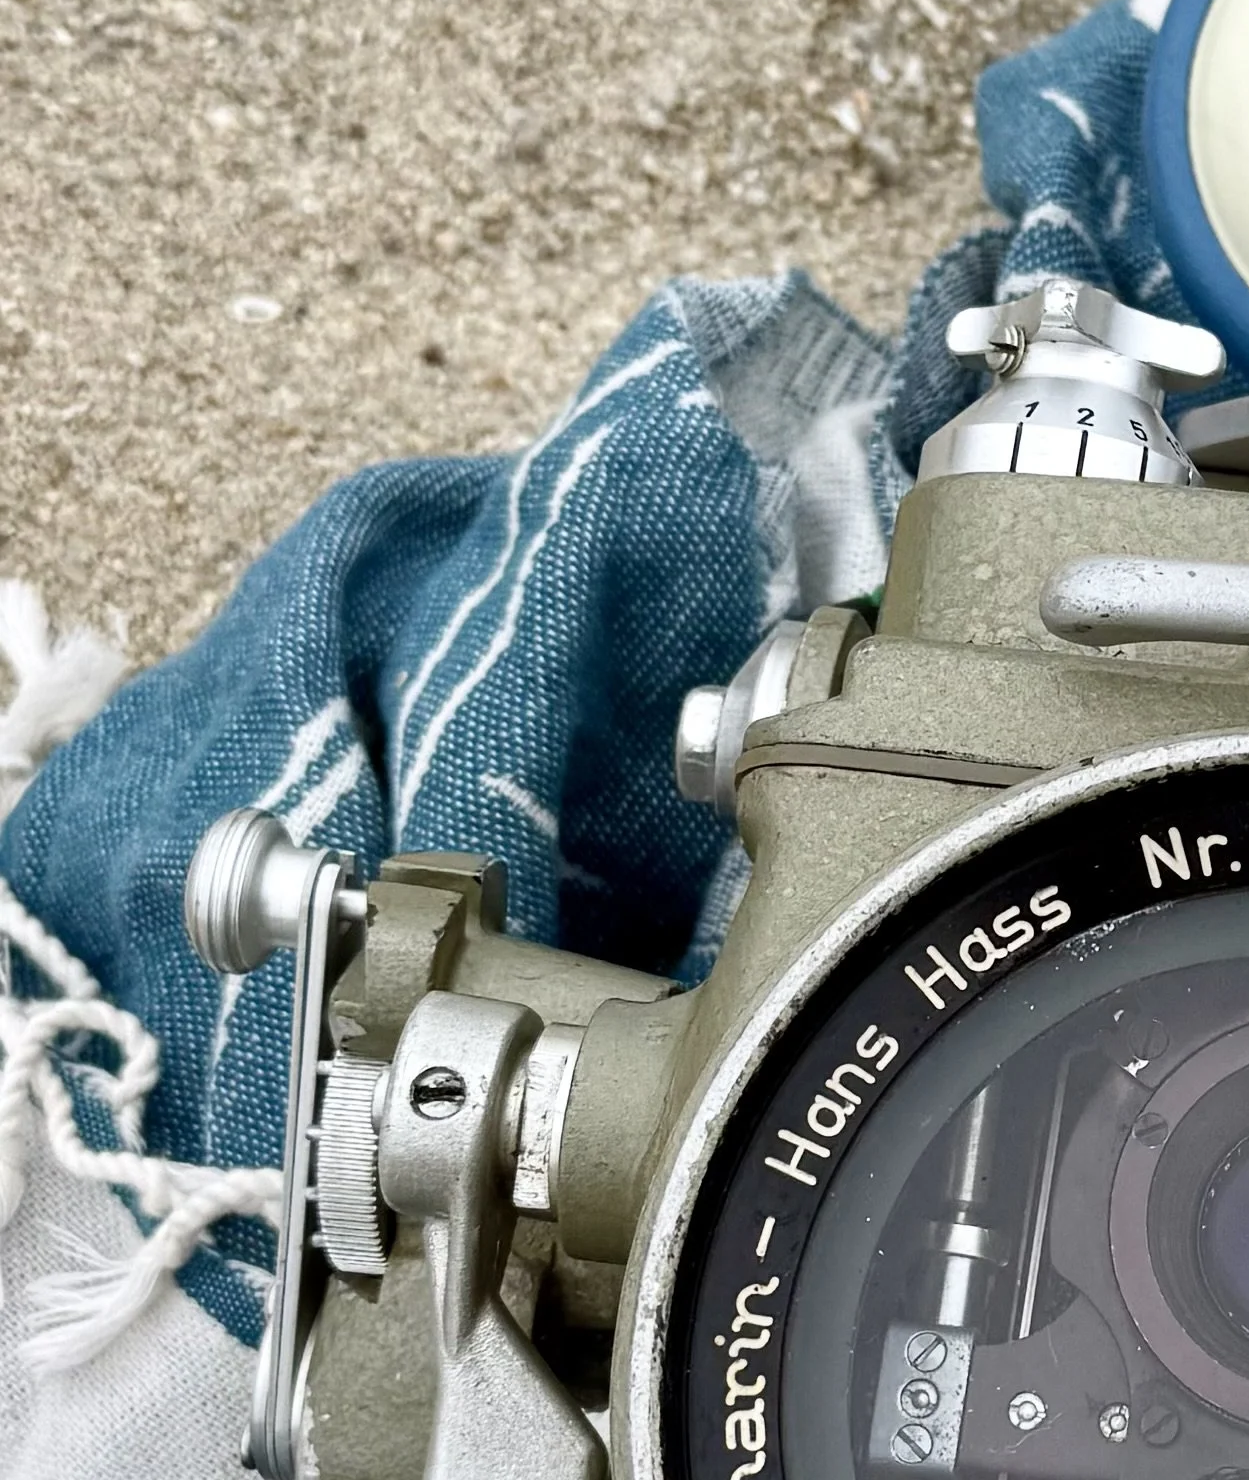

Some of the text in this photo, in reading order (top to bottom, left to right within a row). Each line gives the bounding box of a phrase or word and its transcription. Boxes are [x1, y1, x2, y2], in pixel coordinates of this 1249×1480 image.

[1025, 401, 1149, 442] 1 2 5
[1139, 826, 1243, 889] Nr.
[764, 1024, 900, 1187] Hans
[904, 884, 1073, 1010] Hass
